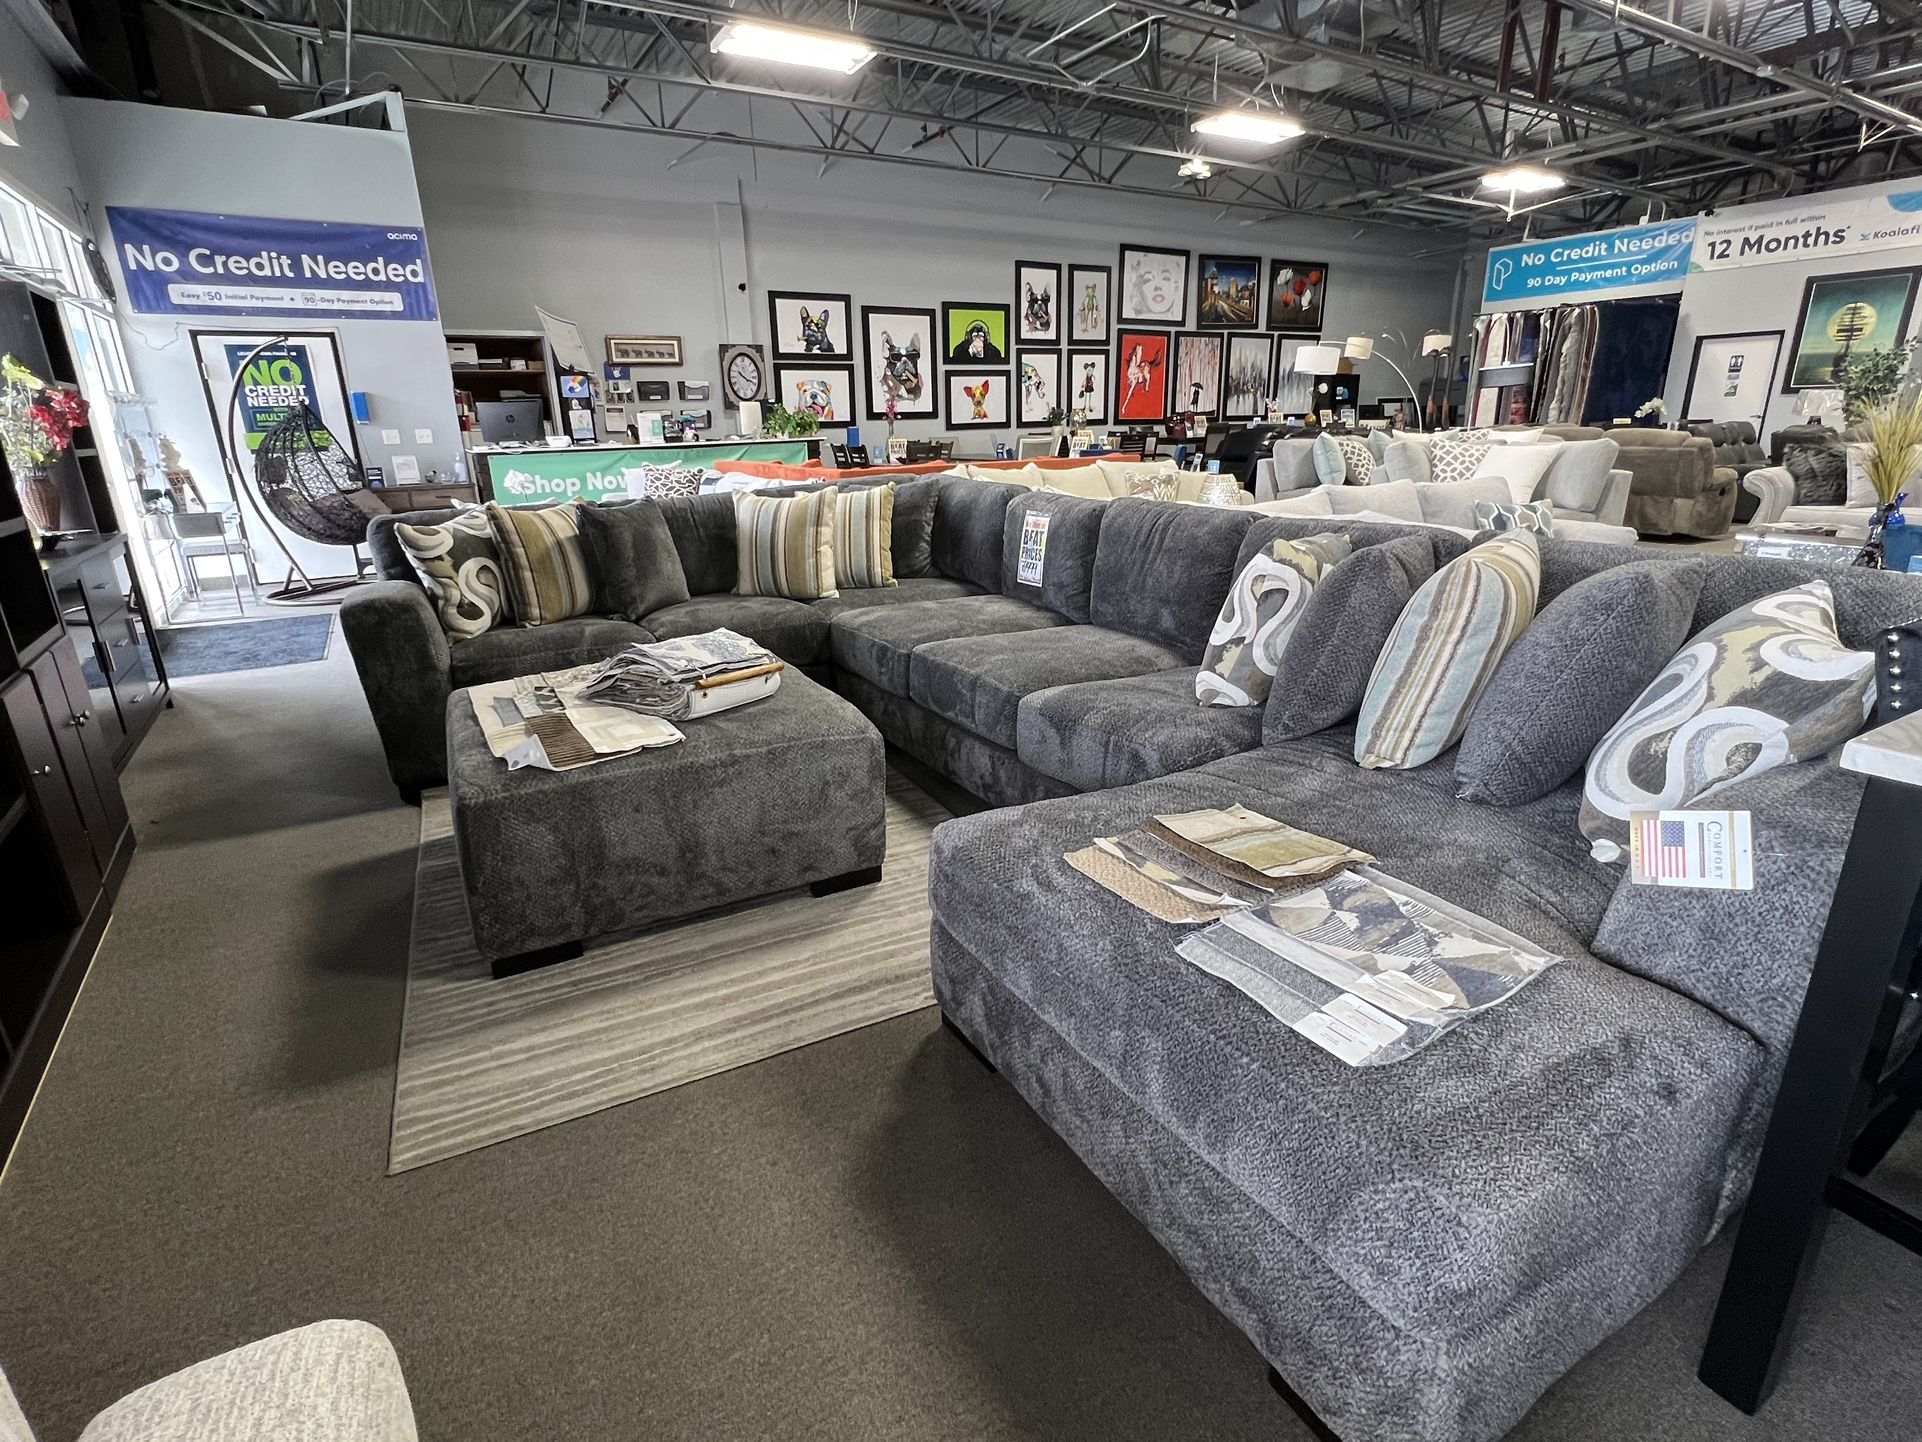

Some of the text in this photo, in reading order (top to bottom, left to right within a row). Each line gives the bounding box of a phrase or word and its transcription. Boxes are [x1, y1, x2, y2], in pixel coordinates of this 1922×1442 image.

[1716, 226, 1746, 236] interest
[1754, 221, 1774, 232] paid
[1785, 217, 1798, 226] full
[1800, 214, 1826, 224] within
[1872, 224, 1921, 240] Koalafi
[387, 232, 418, 241] acima
[1521, 227, 1696, 268] No Credit Needed
[1708, 239, 1732, 261] 12
[123, 243, 425, 283] No Credit Needed
[1526, 259, 1678, 288] 90 Day Payment Option
[181, 291, 200, 300] Easy
[249, 294, 284, 302] Payment
[336, 297, 368, 306] Payment
[369, 298, 394, 306] Option
[240, 359, 302, 387] NO
[244, 384, 306, 397] CREDIT
